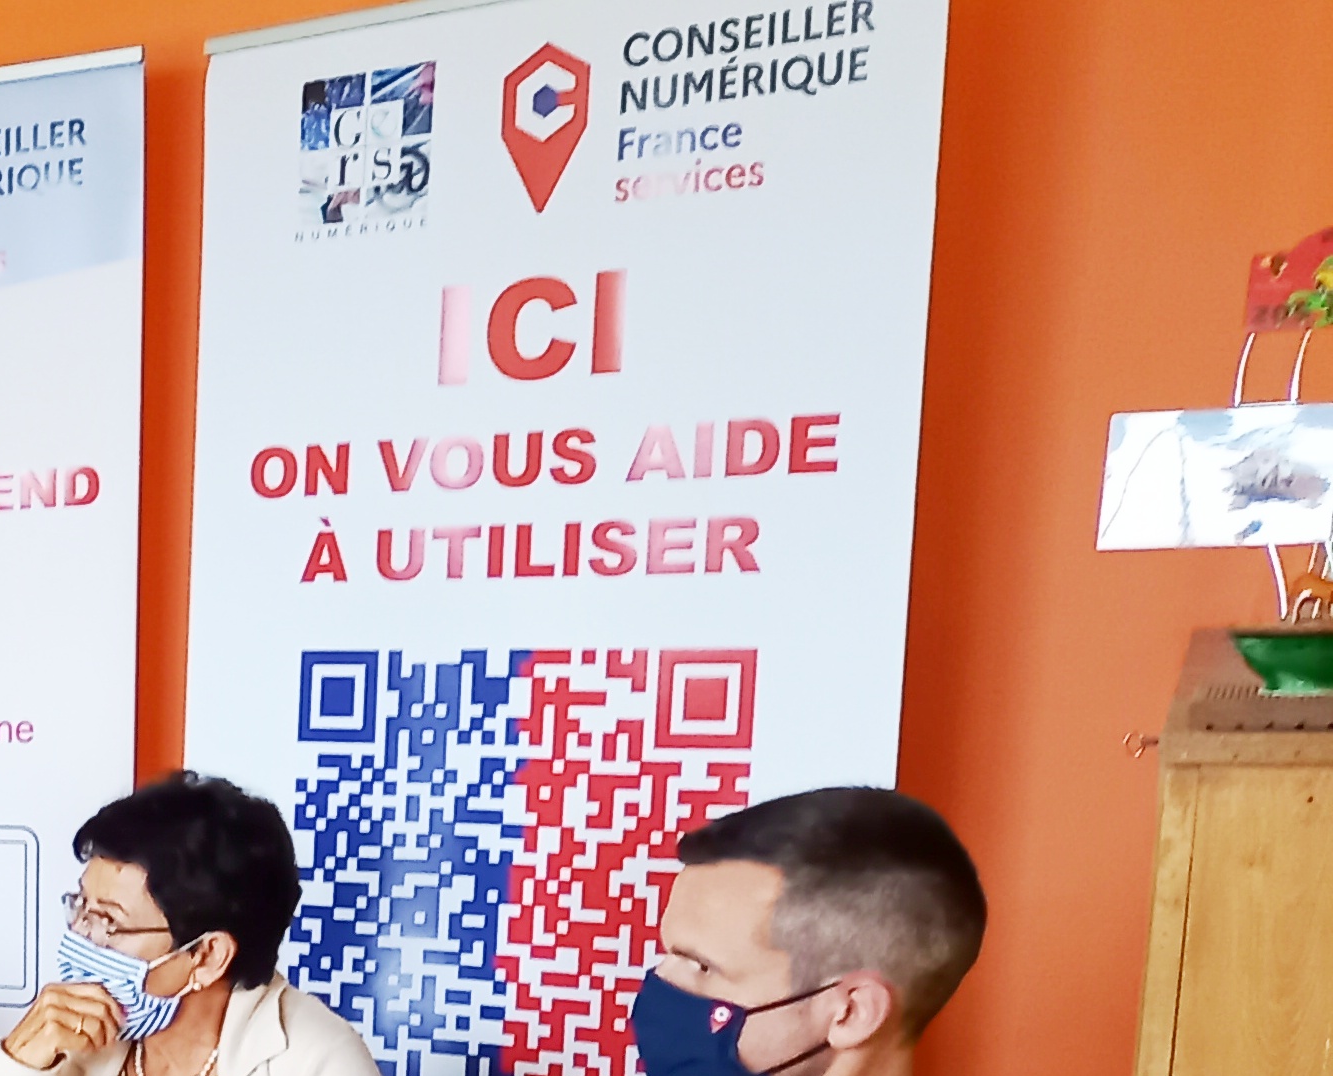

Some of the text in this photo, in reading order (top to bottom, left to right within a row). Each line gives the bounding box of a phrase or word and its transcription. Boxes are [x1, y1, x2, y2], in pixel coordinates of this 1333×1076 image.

[623, 0, 875, 67] CONSEILLER
[619, 45, 871, 115] NUMÉRIQUE
[617, 121, 743, 162] France
[614, 158, 765, 203] services
[437, 268, 628, 386] ICI
[249, 411, 842, 499] ON VOUS AIDE
[299, 514, 761, 583] À UTILISER
